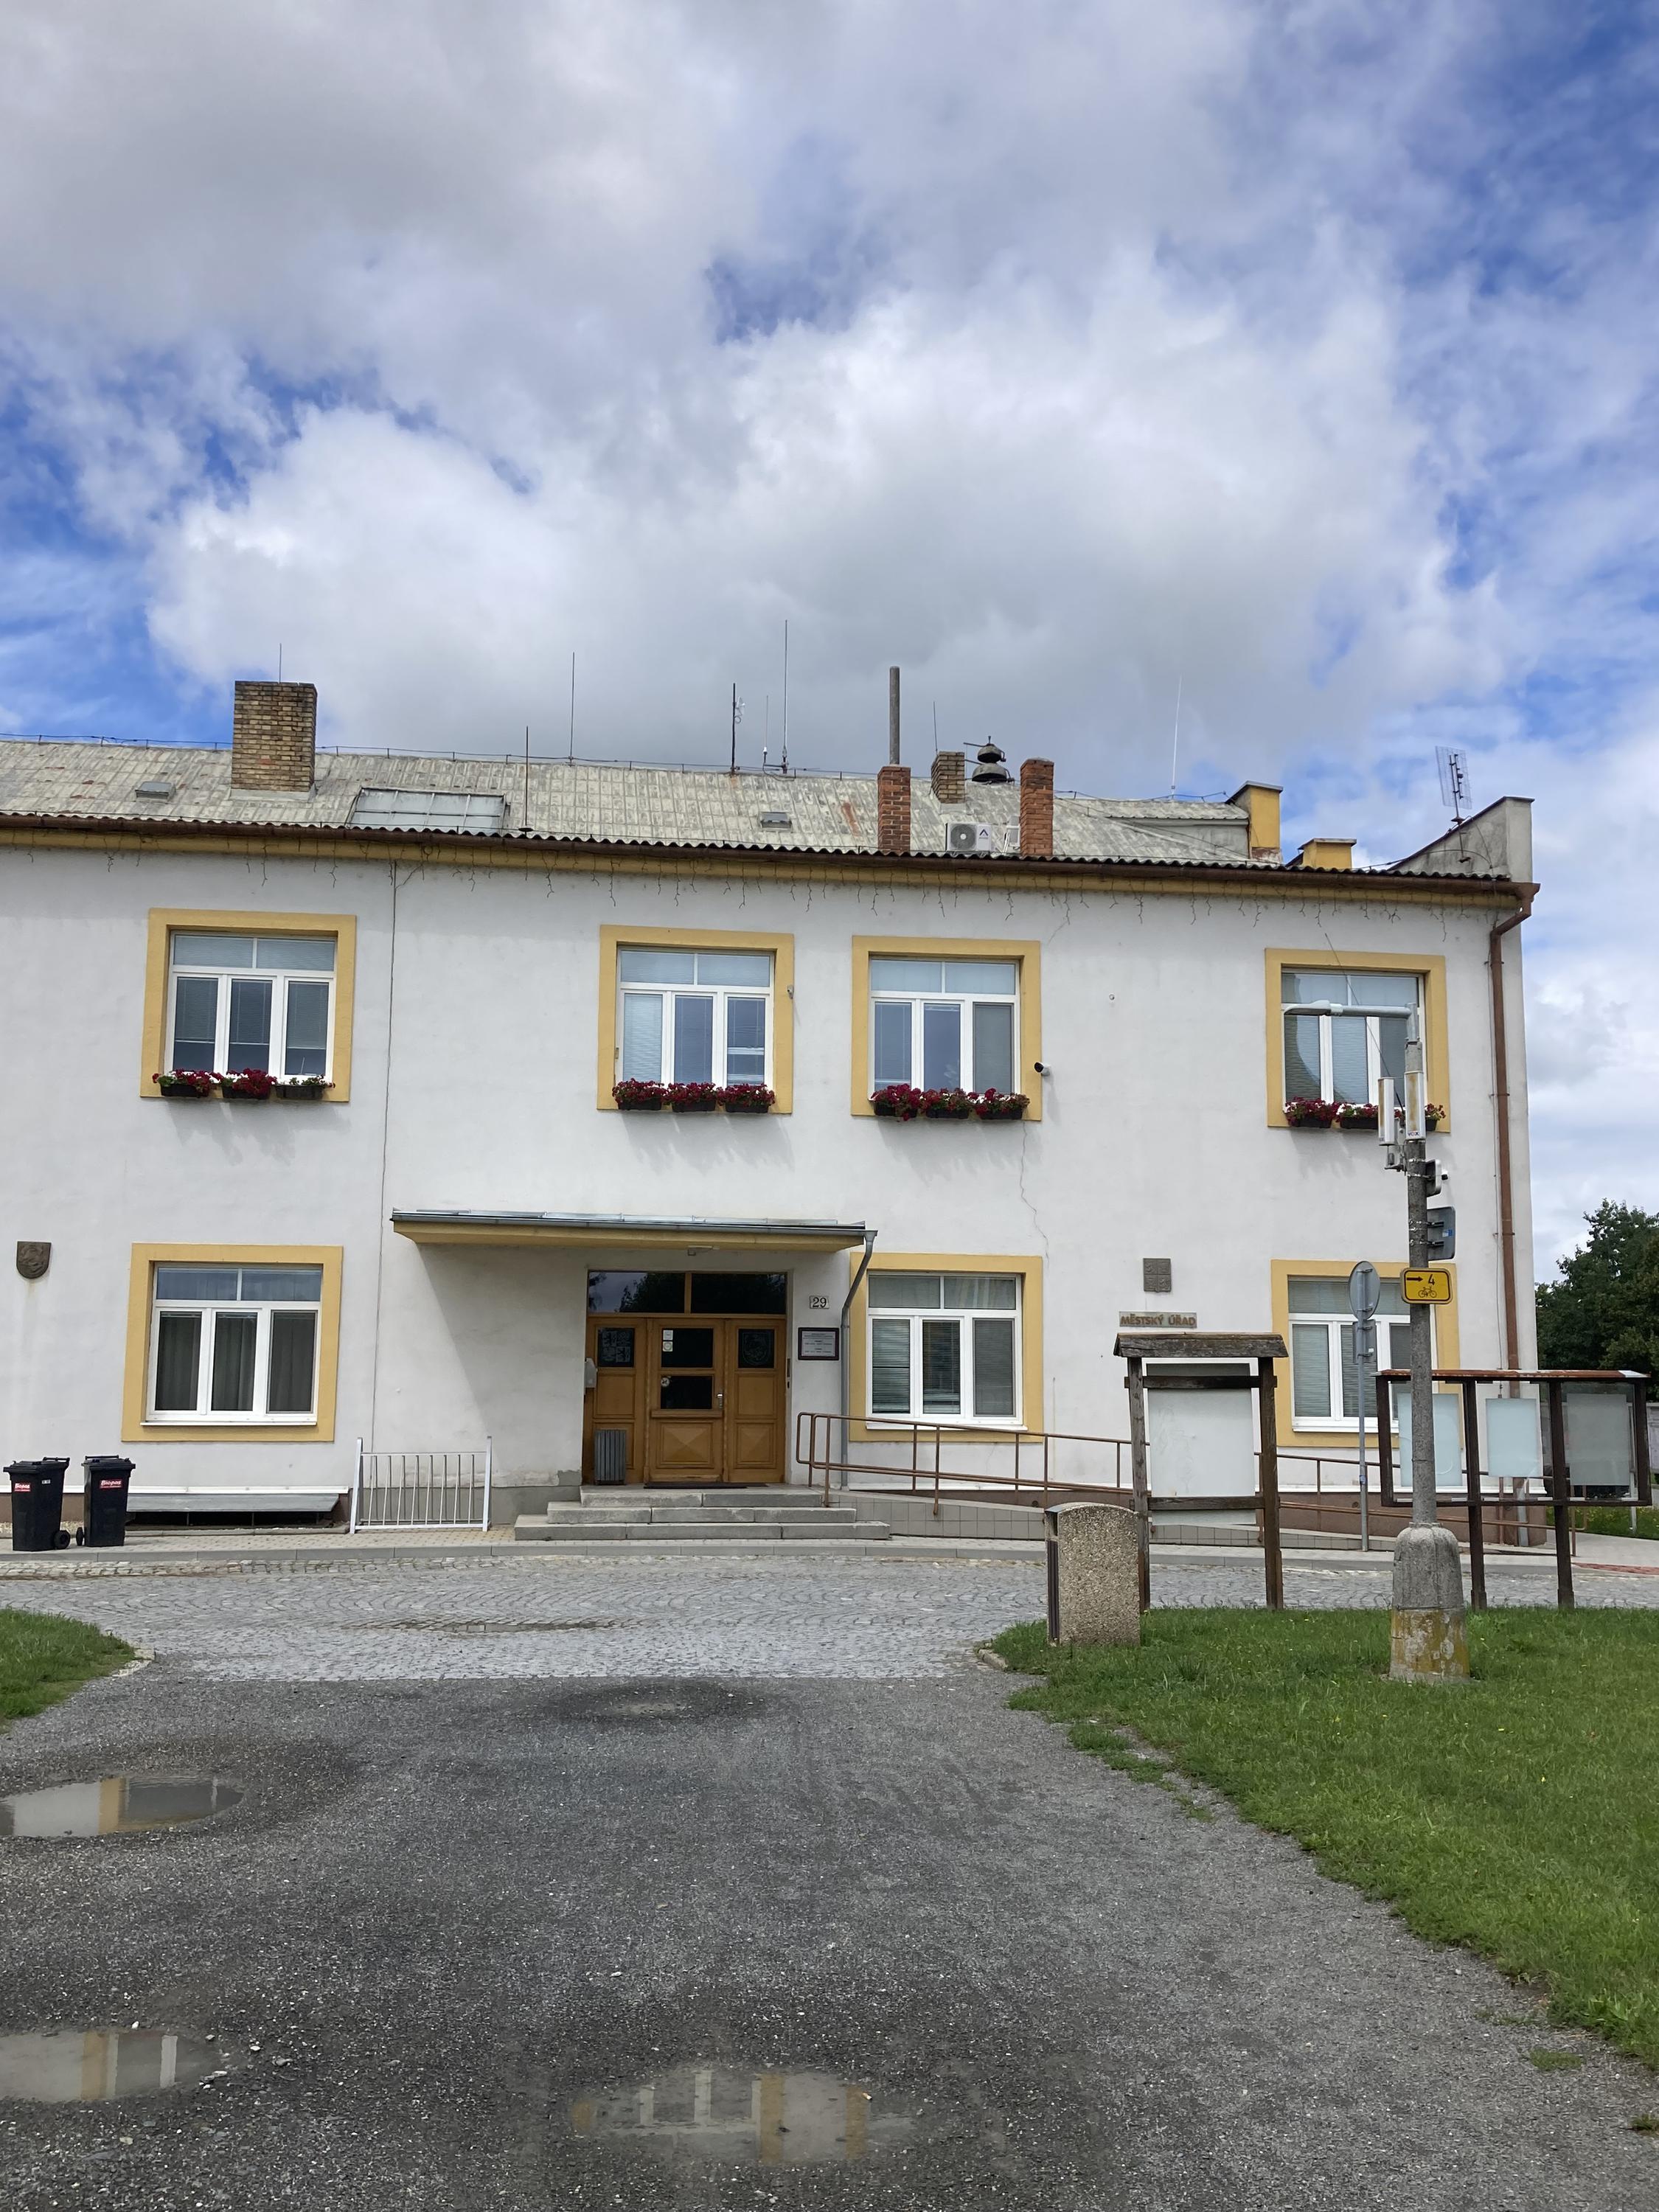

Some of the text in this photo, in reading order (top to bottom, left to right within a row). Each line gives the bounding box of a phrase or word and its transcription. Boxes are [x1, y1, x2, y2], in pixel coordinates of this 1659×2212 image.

[1428, 1274, 1435, 1285] 4
[813, 1297, 827, 1308] 29
[1120, 1313, 1195, 1326] MĚSTSKÝ ÚŘAD
